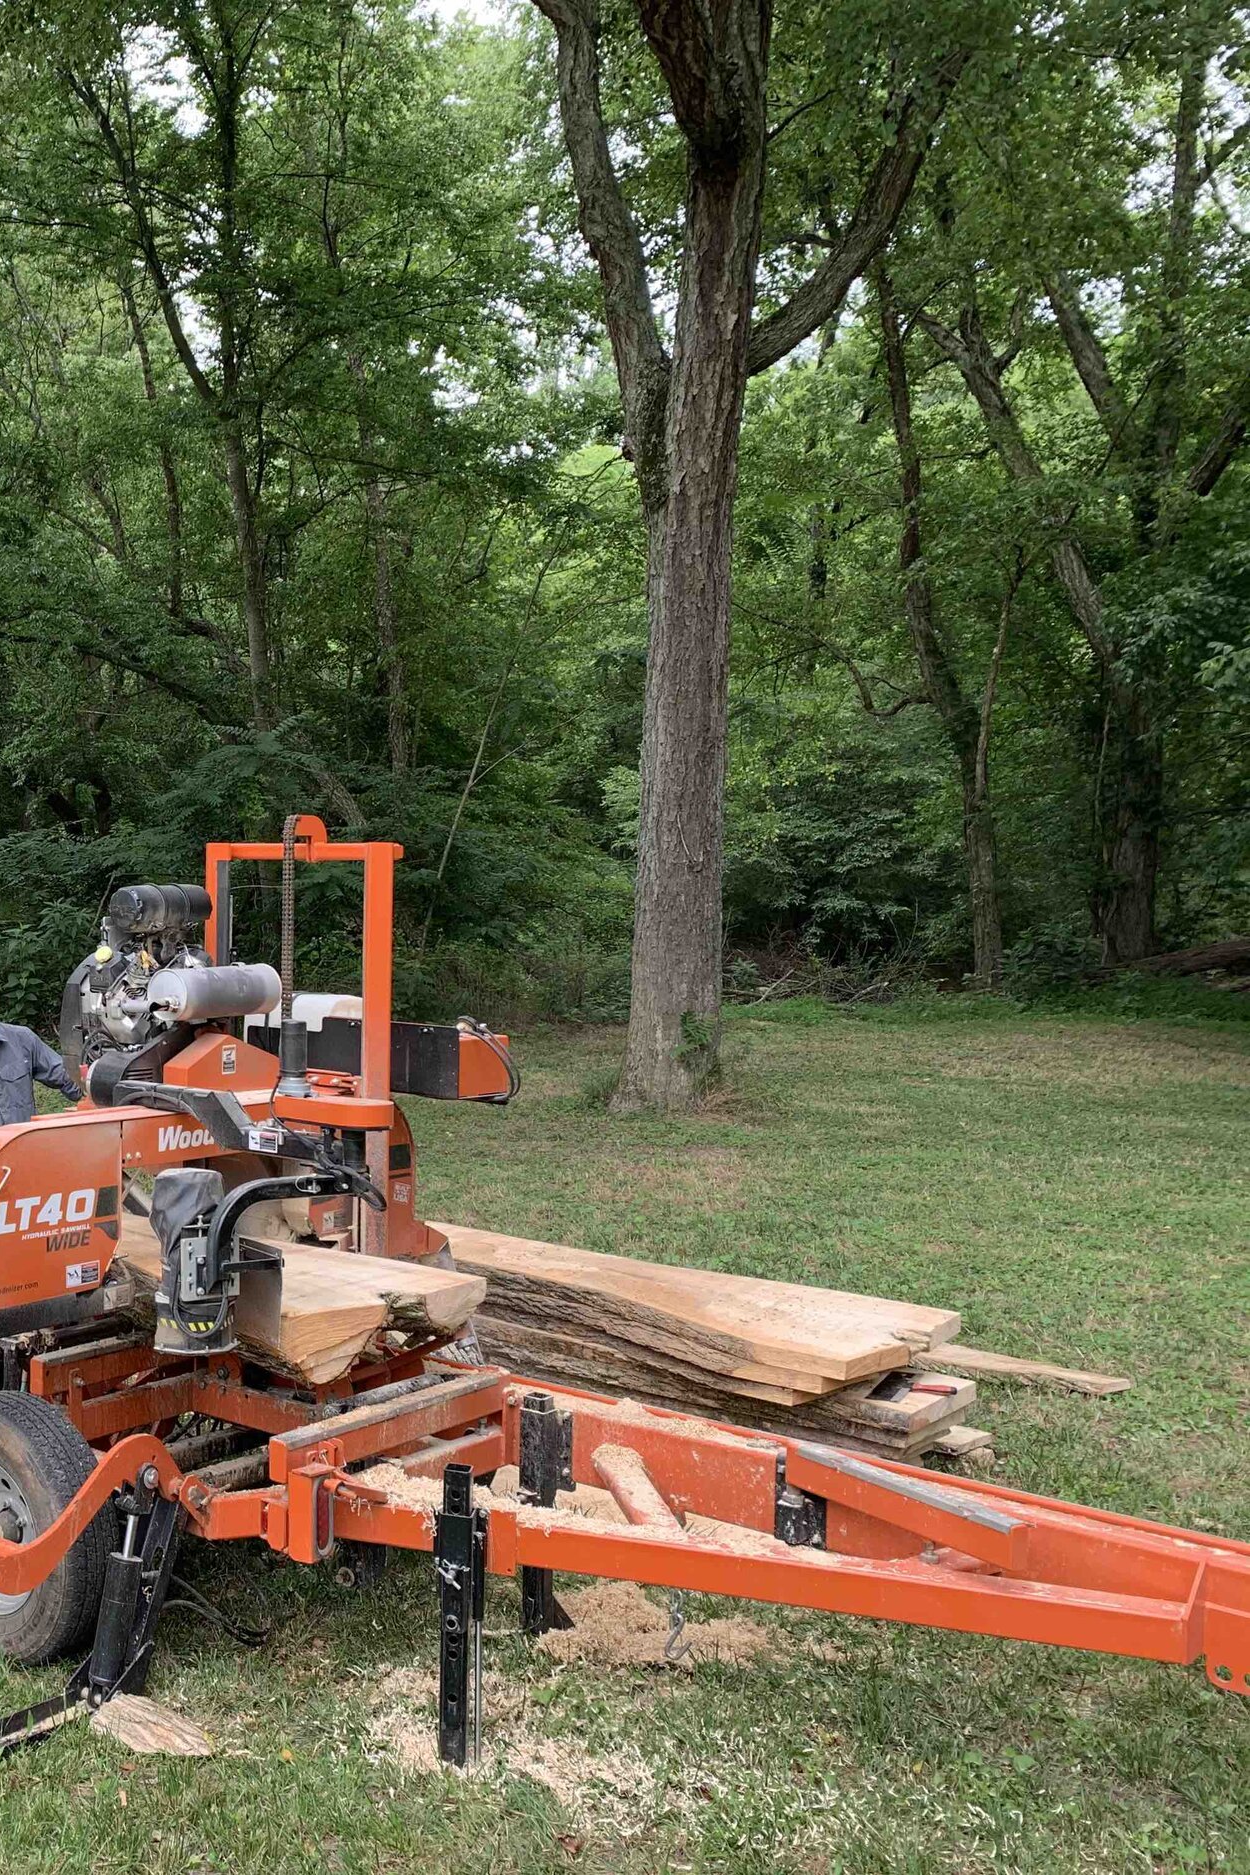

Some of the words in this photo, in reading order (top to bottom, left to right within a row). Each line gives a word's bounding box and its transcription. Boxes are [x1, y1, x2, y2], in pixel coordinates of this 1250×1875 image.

[21, 1228, 60, 1241] HYDRAULIC
[60, 1222, 91, 1235] SAWMILL
[46, 1230, 91, 1253] WIDE
